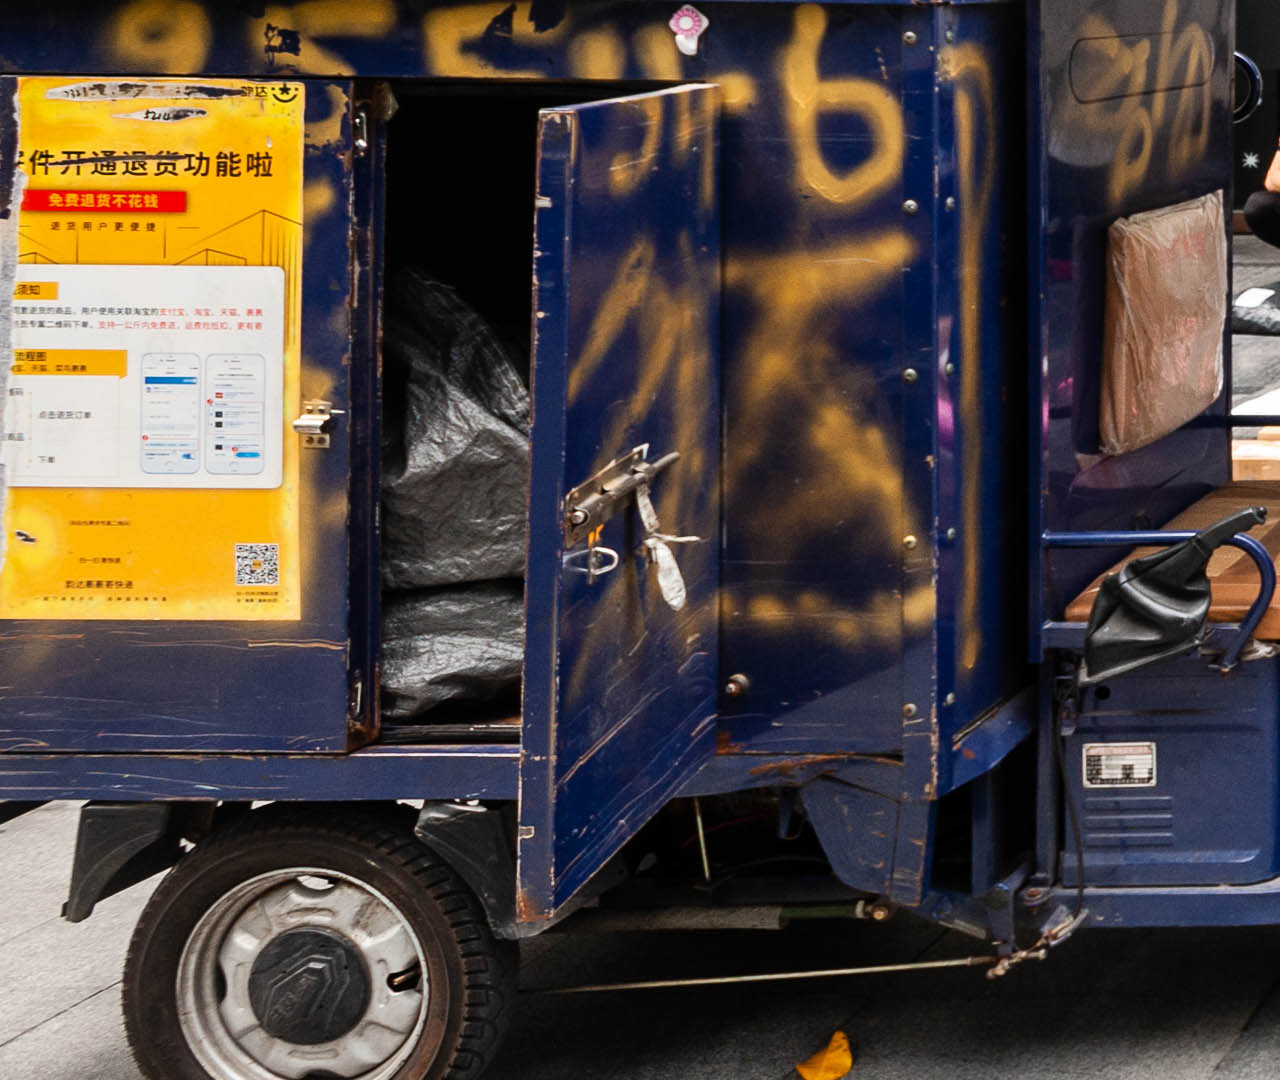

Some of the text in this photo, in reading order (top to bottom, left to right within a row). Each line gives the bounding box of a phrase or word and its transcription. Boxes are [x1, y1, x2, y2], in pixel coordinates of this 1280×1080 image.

[48, 193, 159, 209] 免费退货不花钱
[13, 284, 41, 297] 须知
